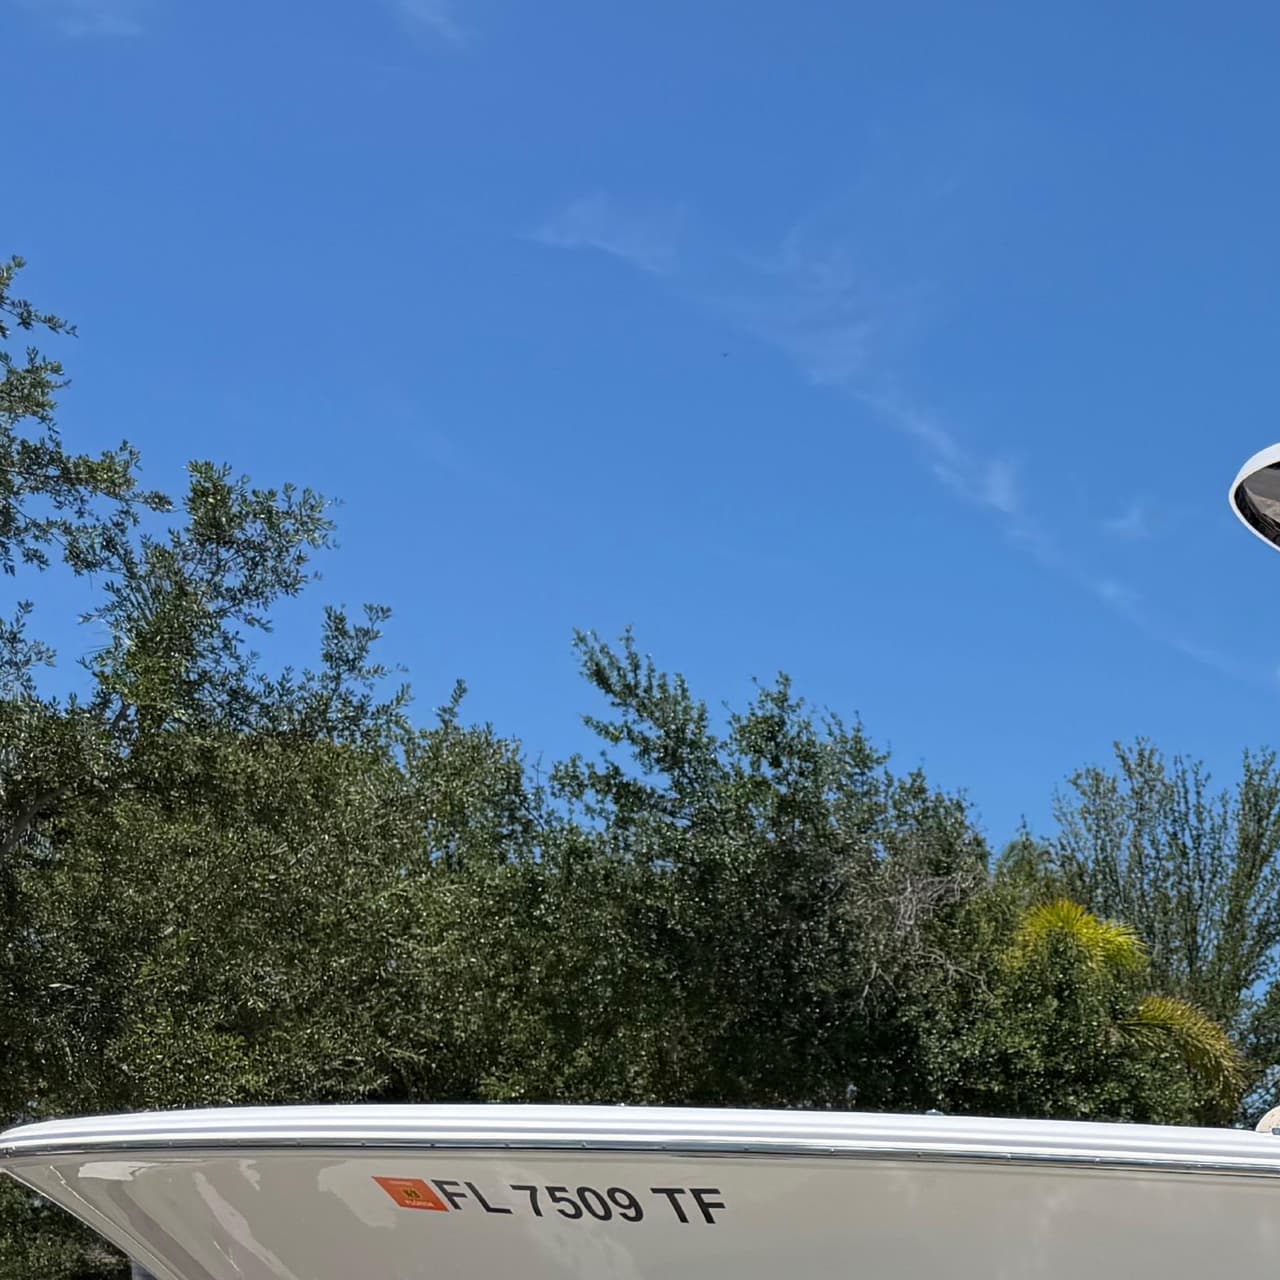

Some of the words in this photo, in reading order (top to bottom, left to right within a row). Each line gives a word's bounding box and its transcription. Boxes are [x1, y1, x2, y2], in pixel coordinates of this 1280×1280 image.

[430, 1180, 513, 1215] FL
[510, 1184, 644, 1222] 7509
[650, 1187, 726, 1224] TF
